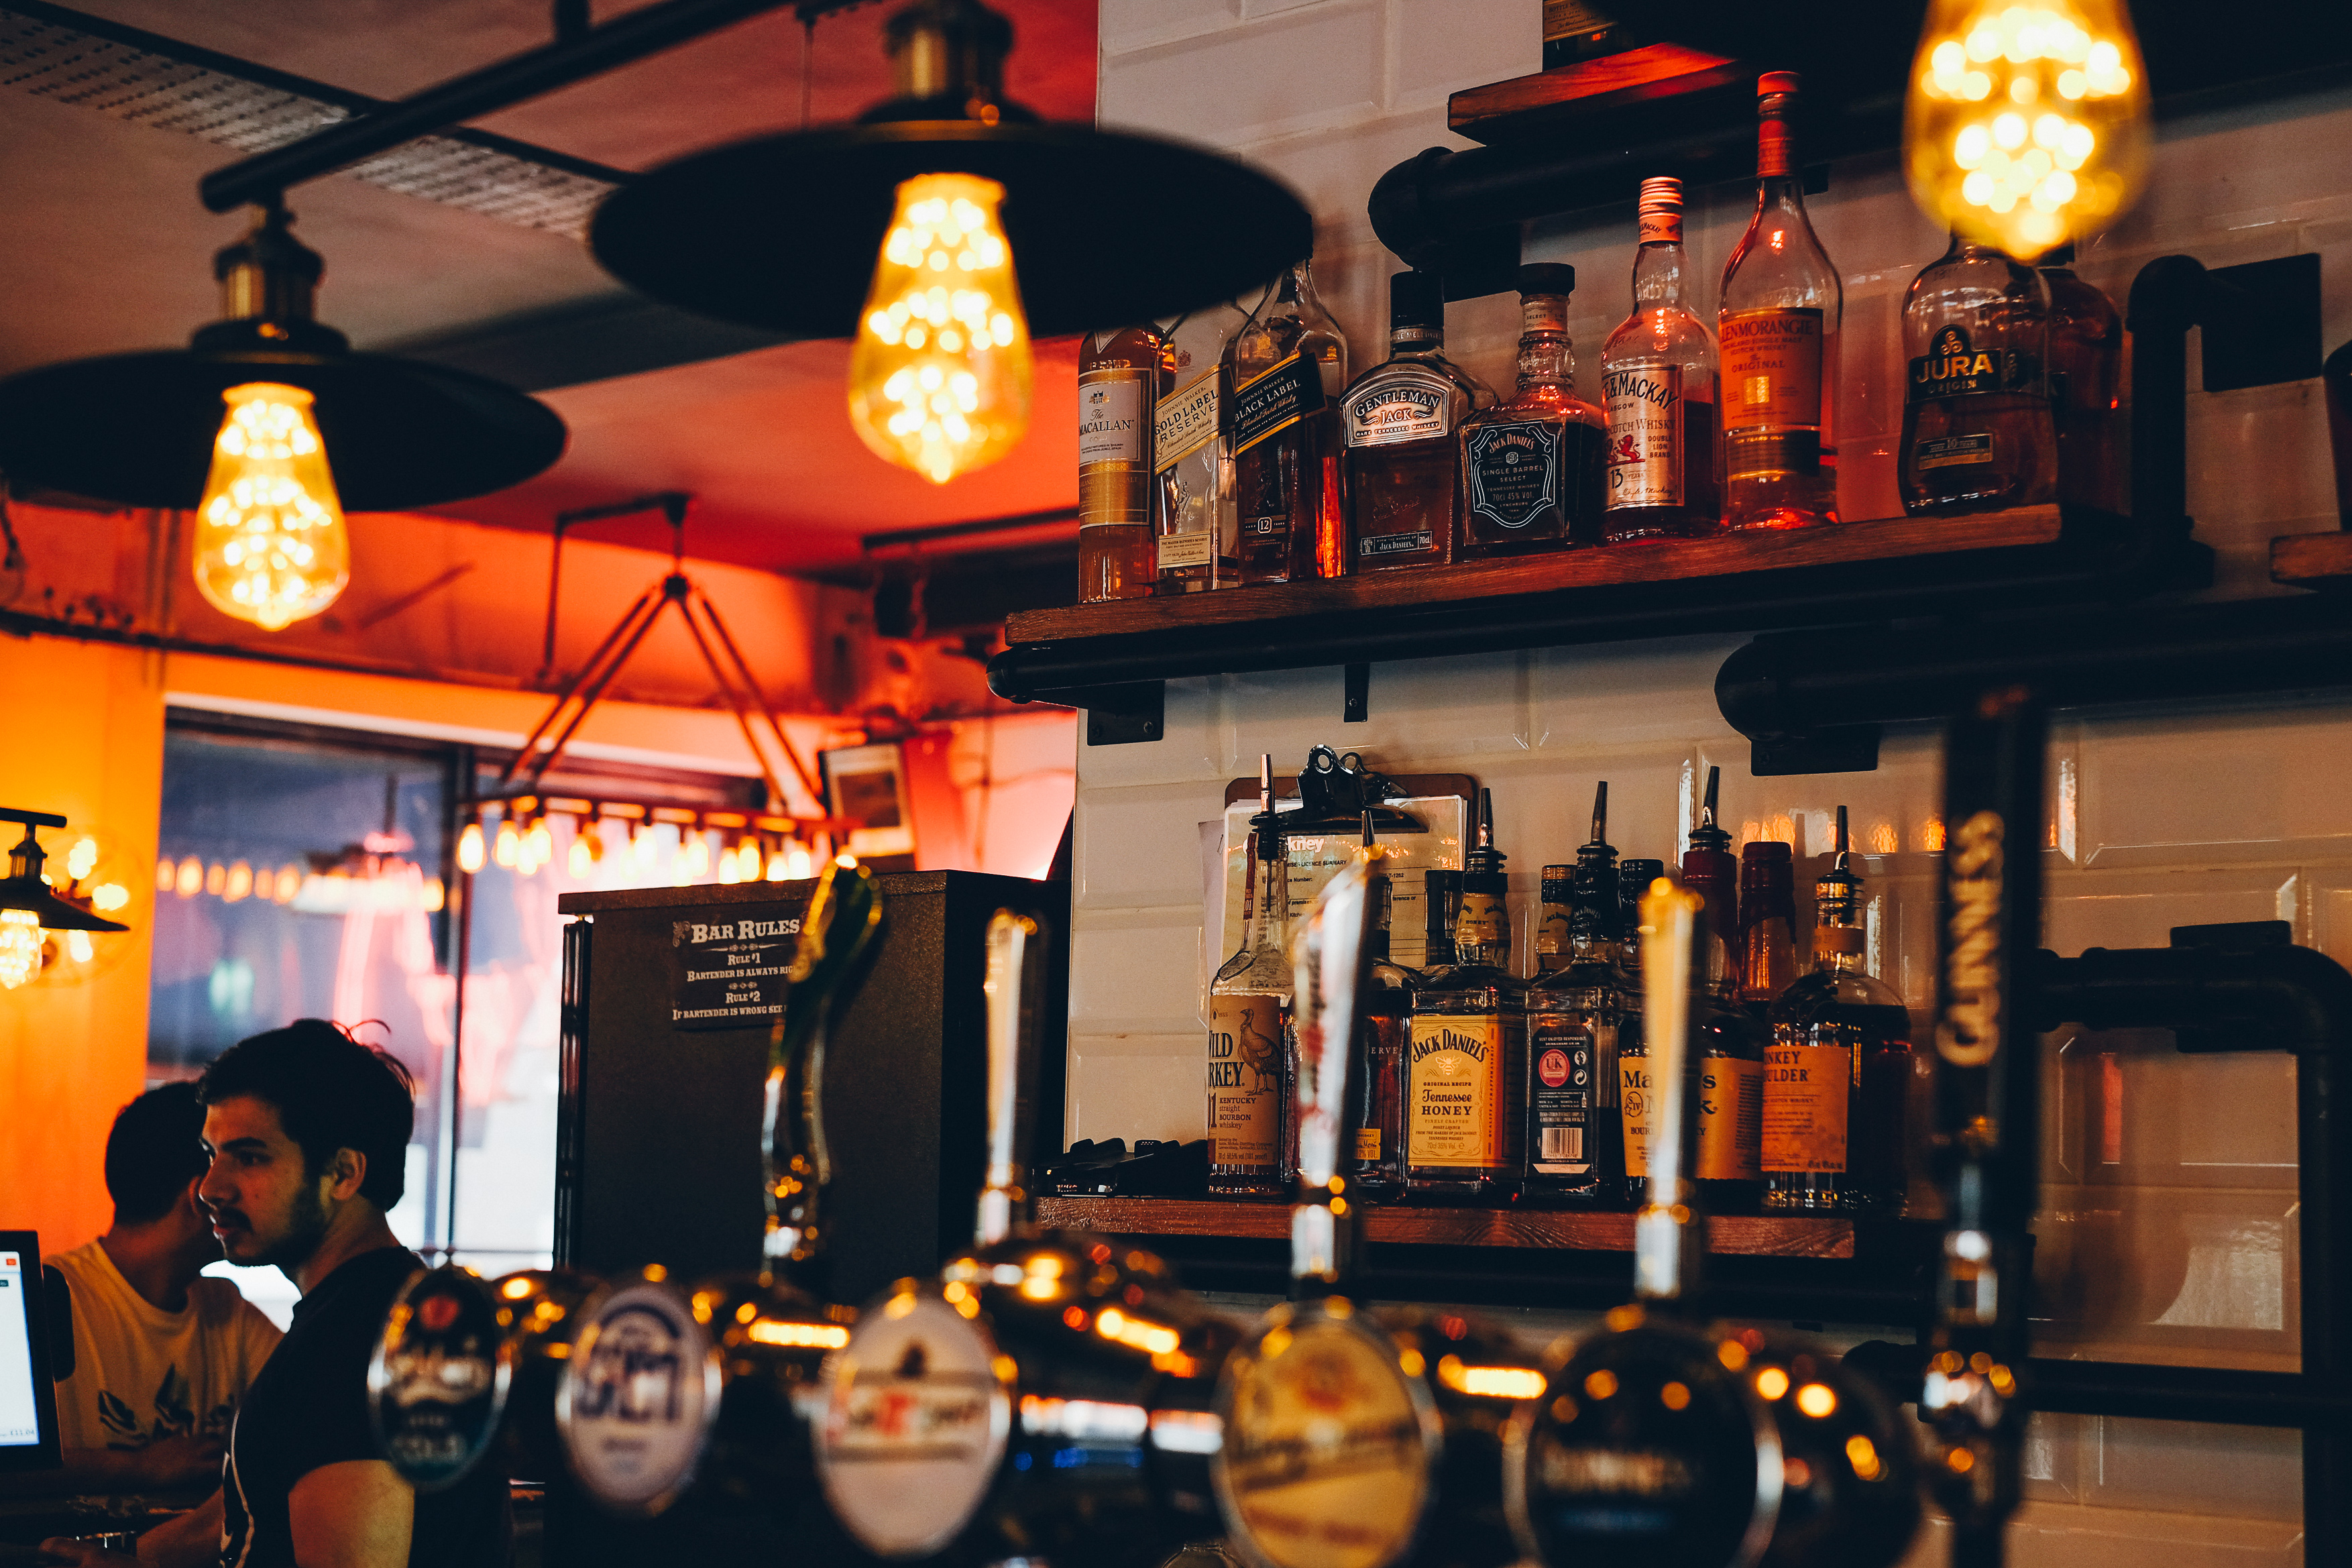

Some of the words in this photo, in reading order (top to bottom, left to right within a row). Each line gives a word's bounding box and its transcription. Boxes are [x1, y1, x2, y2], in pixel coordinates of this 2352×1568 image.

[1732, 360, 1786, 373] ORIGINAL
[1916, 353, 1994, 383] JURA
[1241, 389, 1263, 406] JOHNNIE
[1264, 377, 1284, 390] WALKER
[1618, 372, 1678, 410] MACKAY
[1928, 379, 1976, 394] ORIGIN
[1162, 401, 1182, 417] JOHNNIE
[1184, 388, 1205, 402] WALKER
[1235, 398, 1265, 423] BLACK
[1267, 379, 1300, 402] LABEL
[1355, 391, 1439, 416] GENTLEMAN
[1608, 402, 1634, 412] ASGOW
[1090, 409, 1104, 421] The
[1155, 412, 1181, 435] GOLD
[1182, 390, 1219, 416] LABEL
[1381, 408, 1411, 425] JACK
[1080, 420, 1131, 436] MACALLAN
[1161, 402, 1217, 443] RESERVE
[1374, 426, 1409, 435] TENNESSEE
[1412, 421, 1439, 430] WHISKEY
[1636, 418, 1675, 429] WHISKY
[1489, 438, 1506, 454] JACK
[1507, 433, 1535, 450] DANIEL'S
[1482, 468, 1510, 476] SINGLE
[1513, 465, 1544, 473] BARREL
[1610, 469, 1623, 489] 13
[1260, 520, 1269, 530] 12
[1380, 543, 1392, 551] JACK
[1288, 836, 1325, 852] kney
[691, 924, 734, 944] BAR
[738, 919, 800, 940] RULES
[728, 954, 750, 966] RULE
[751, 953, 761, 964] #1
[687, 970, 735, 982] BARTENDER
[736, 969, 744, 977] IS
[746, 966, 779, 976] ALWAYS
[780, 966, 795, 974] RIG
[726, 992, 748, 1004] RULE
[749, 991, 761, 1002] #2
[673, 1009, 682, 1020] IF
[683, 1009, 729, 1019] BARTENDER
[739, 1006, 767, 1015] WRONG
[769, 1005, 783, 1013] SEE
[1412, 1035, 1442, 1063] JACK
[1443, 1029, 1490, 1063] DANIEL'S
[1547, 1058, 1562, 1068] UK
[1765, 1051, 1801, 1064] NKEY
[1209, 1062, 1245, 1090] RKEY
[1765, 1068, 1808, 1082] ULDER
[1422, 1089, 1472, 1102] Tennessee
[1219, 1105, 1240, 1113] straight
[1421, 1106, 1472, 1115] HONEY
[1219, 1121, 1242, 1130] whiskey
[1630, 1127, 1654, 1135] BOUR
